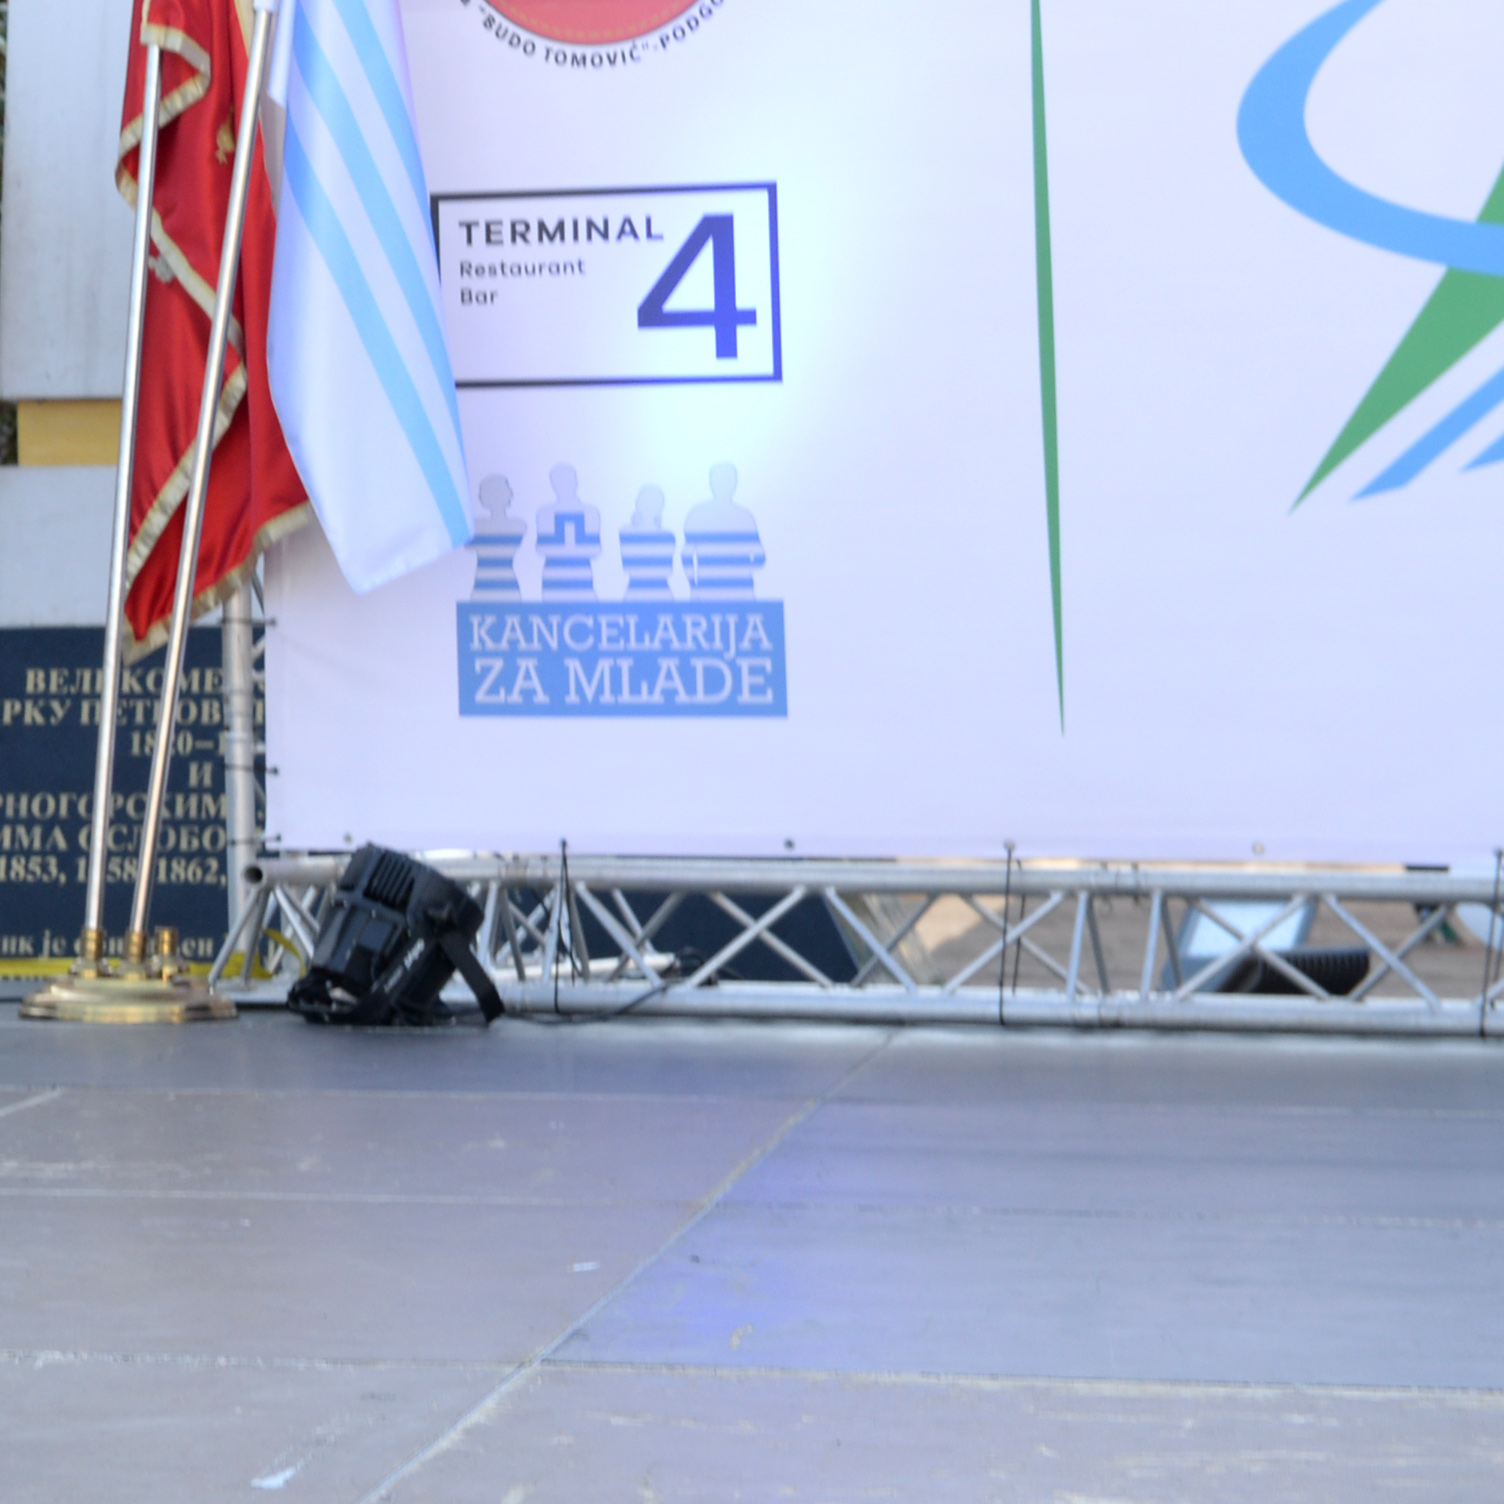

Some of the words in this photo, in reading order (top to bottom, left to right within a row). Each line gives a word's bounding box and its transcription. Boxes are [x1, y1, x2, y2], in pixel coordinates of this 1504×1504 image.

[458, 215, 664, 247] TERMINAL
[459, 258, 585, 280] Restaurant
[459, 287, 497, 306] Bar
[637, 213, 757, 359] 4
[469, 613, 772, 658] KANCELARIJA
[474, 658, 550, 705] ZA
[564, 656, 774, 705] MLADE
[188, 762, 213, 788] И
[156, 856, 227, 888] 1862,
